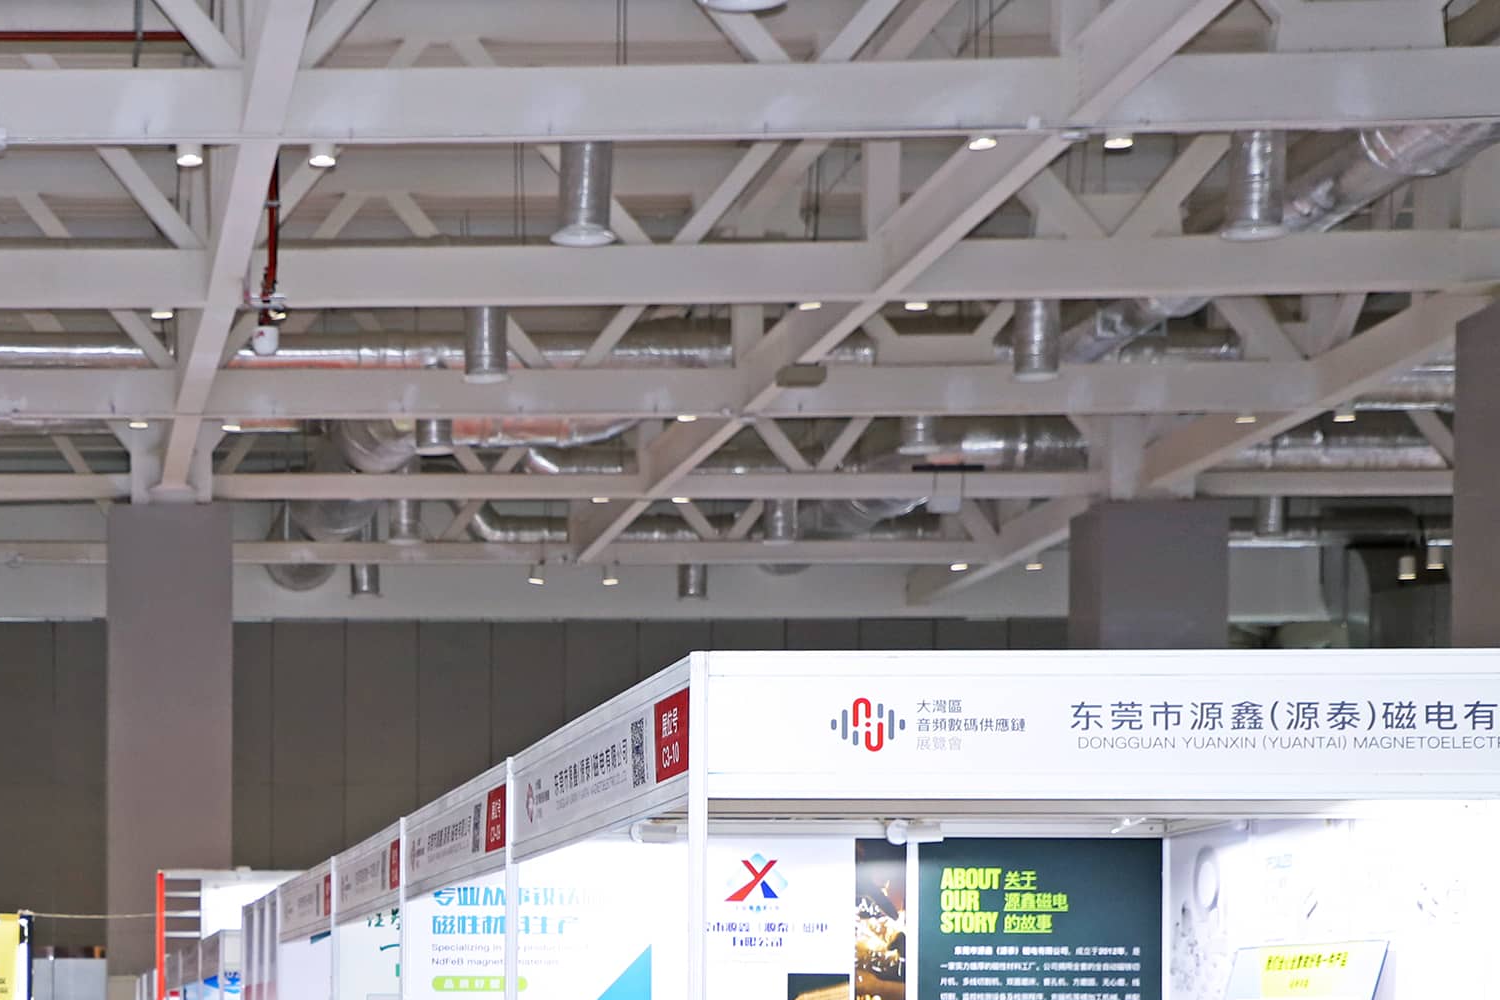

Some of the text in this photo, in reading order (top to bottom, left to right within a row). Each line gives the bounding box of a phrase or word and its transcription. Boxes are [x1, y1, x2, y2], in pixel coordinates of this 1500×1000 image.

[916, 699, 963, 714] 大灣區
[916, 717, 1027, 733] 音頻數碼供應鏈
[1078, 736, 1176, 750] DONGGUAN
[1181, 736, 1256, 750] YUANXIN
[1262, 736, 1348, 751] (YUANTAI)
[662, 741, 680, 769] C3-10
[940, 868, 1002, 889] ABOUT
[1004, 870, 1038, 889] 关于
[940, 890, 980, 911] OUR
[940, 912, 999, 933] STORY
[1003, 914, 1053, 933] 的故事
[431, 943, 490, 953] Specializing
